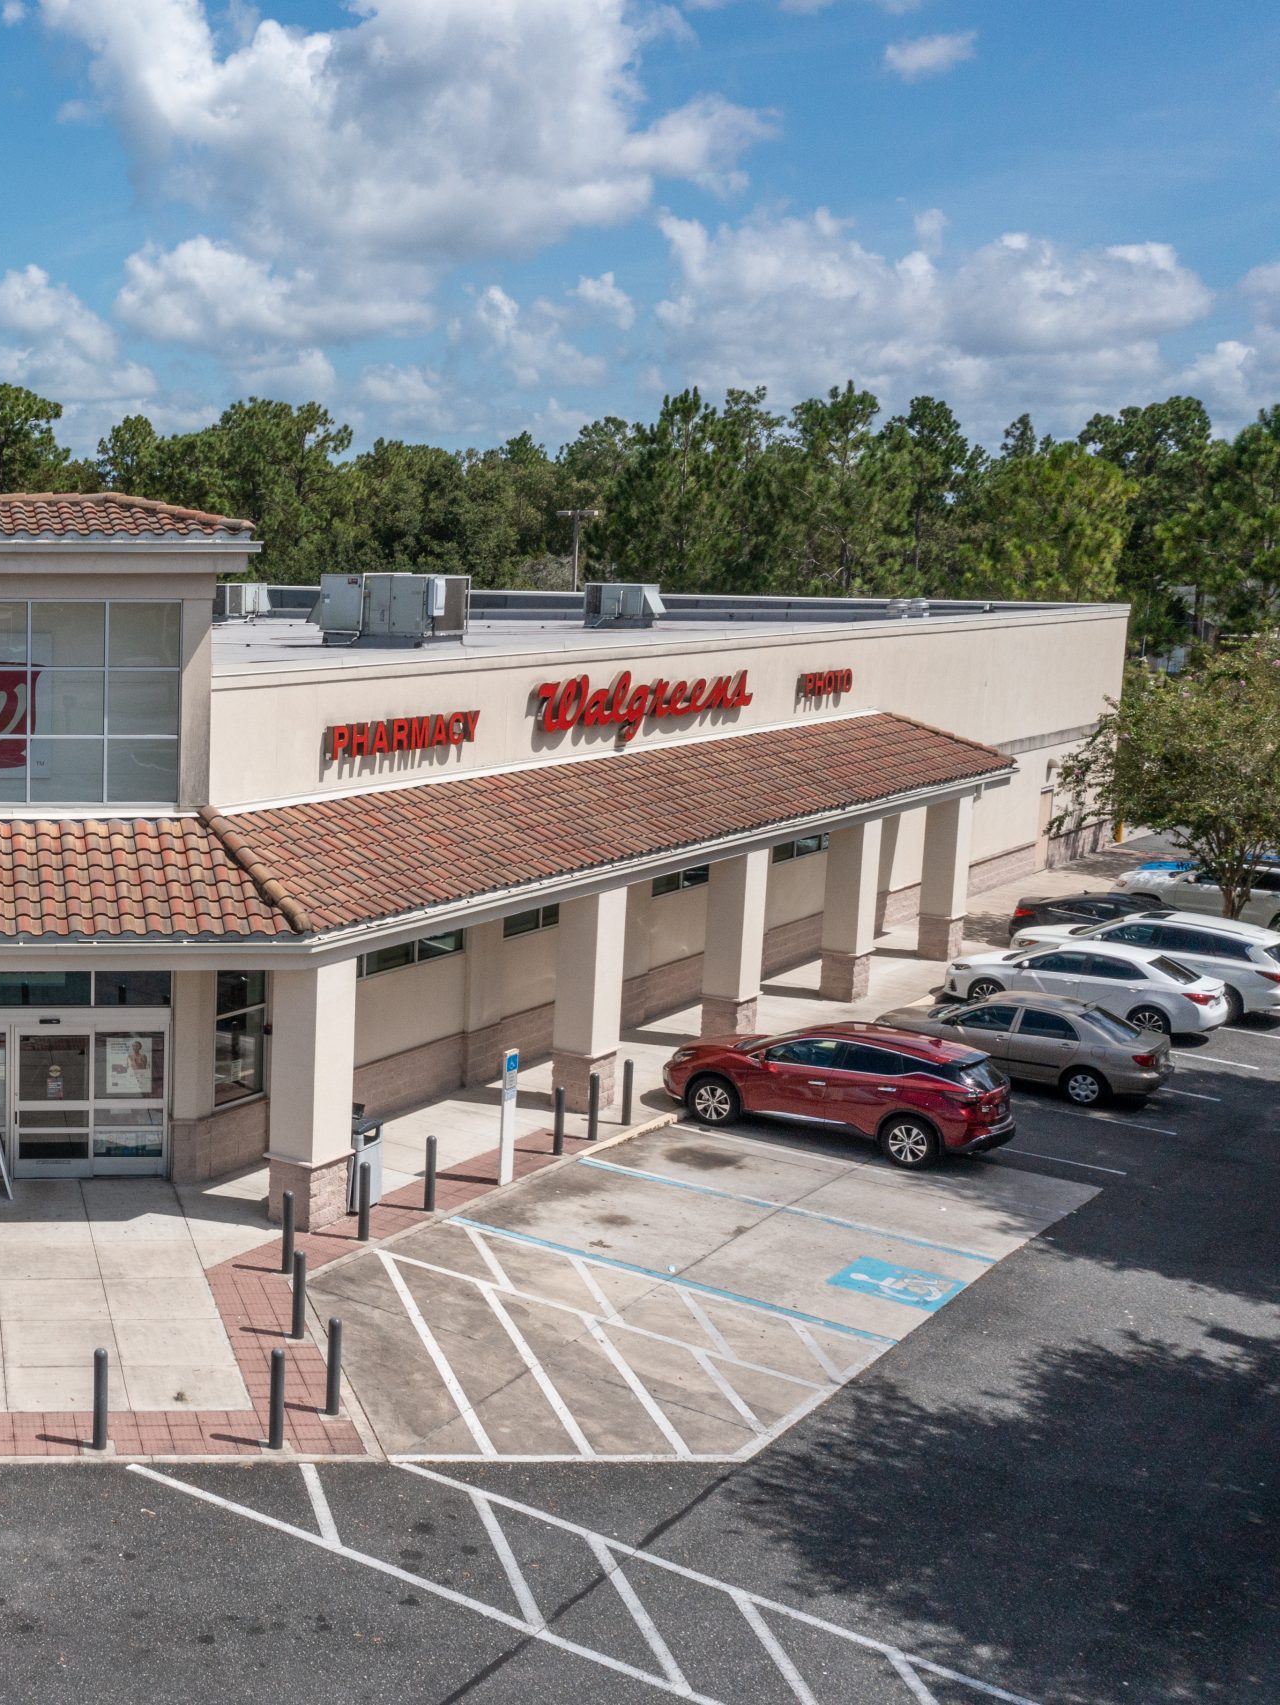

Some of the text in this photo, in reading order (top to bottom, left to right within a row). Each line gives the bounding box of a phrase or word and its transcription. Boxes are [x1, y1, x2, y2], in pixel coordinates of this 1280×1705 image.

[536, 670, 753, 742] Walgreens
[804, 668, 853, 698] PHOTO
[331, 710, 480, 761] PHARMACY
